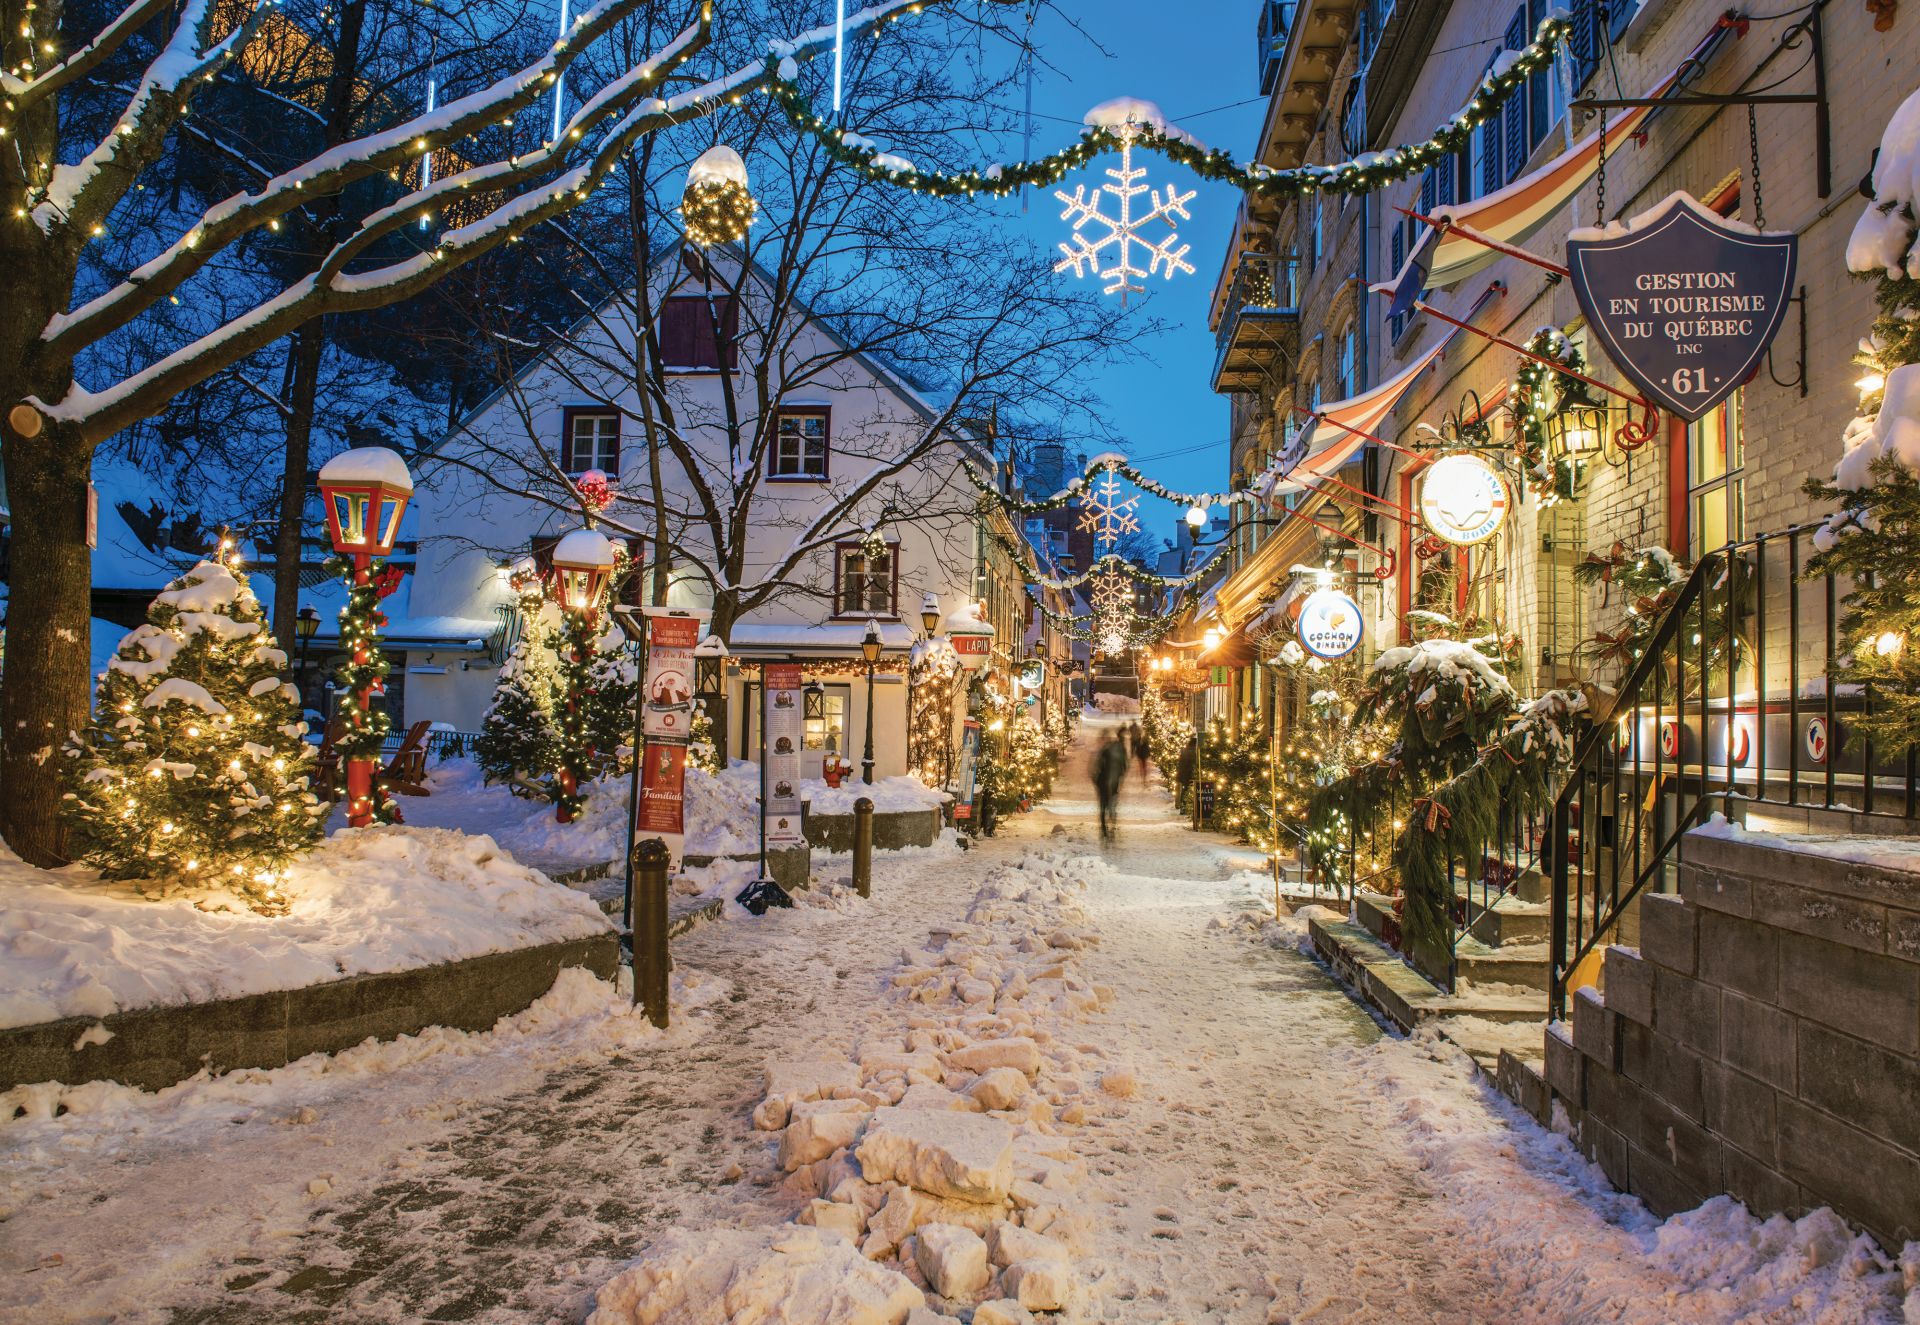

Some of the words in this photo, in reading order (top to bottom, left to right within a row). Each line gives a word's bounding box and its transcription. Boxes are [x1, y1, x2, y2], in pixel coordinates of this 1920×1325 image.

[1635, 272, 1736, 291] GESTION
[1609, 298, 1639, 315] EN
[1649, 295, 1766, 314] TOURISME
[1623, 321, 1654, 338] DU
[1664, 316, 1753, 340] QUÉBEC
[1675, 343, 1703, 355] INC
[1462, 519, 1496, 540] BORD
[966, 639, 989, 652] LAPIN
[1309, 631, 1353, 642] COCHON
